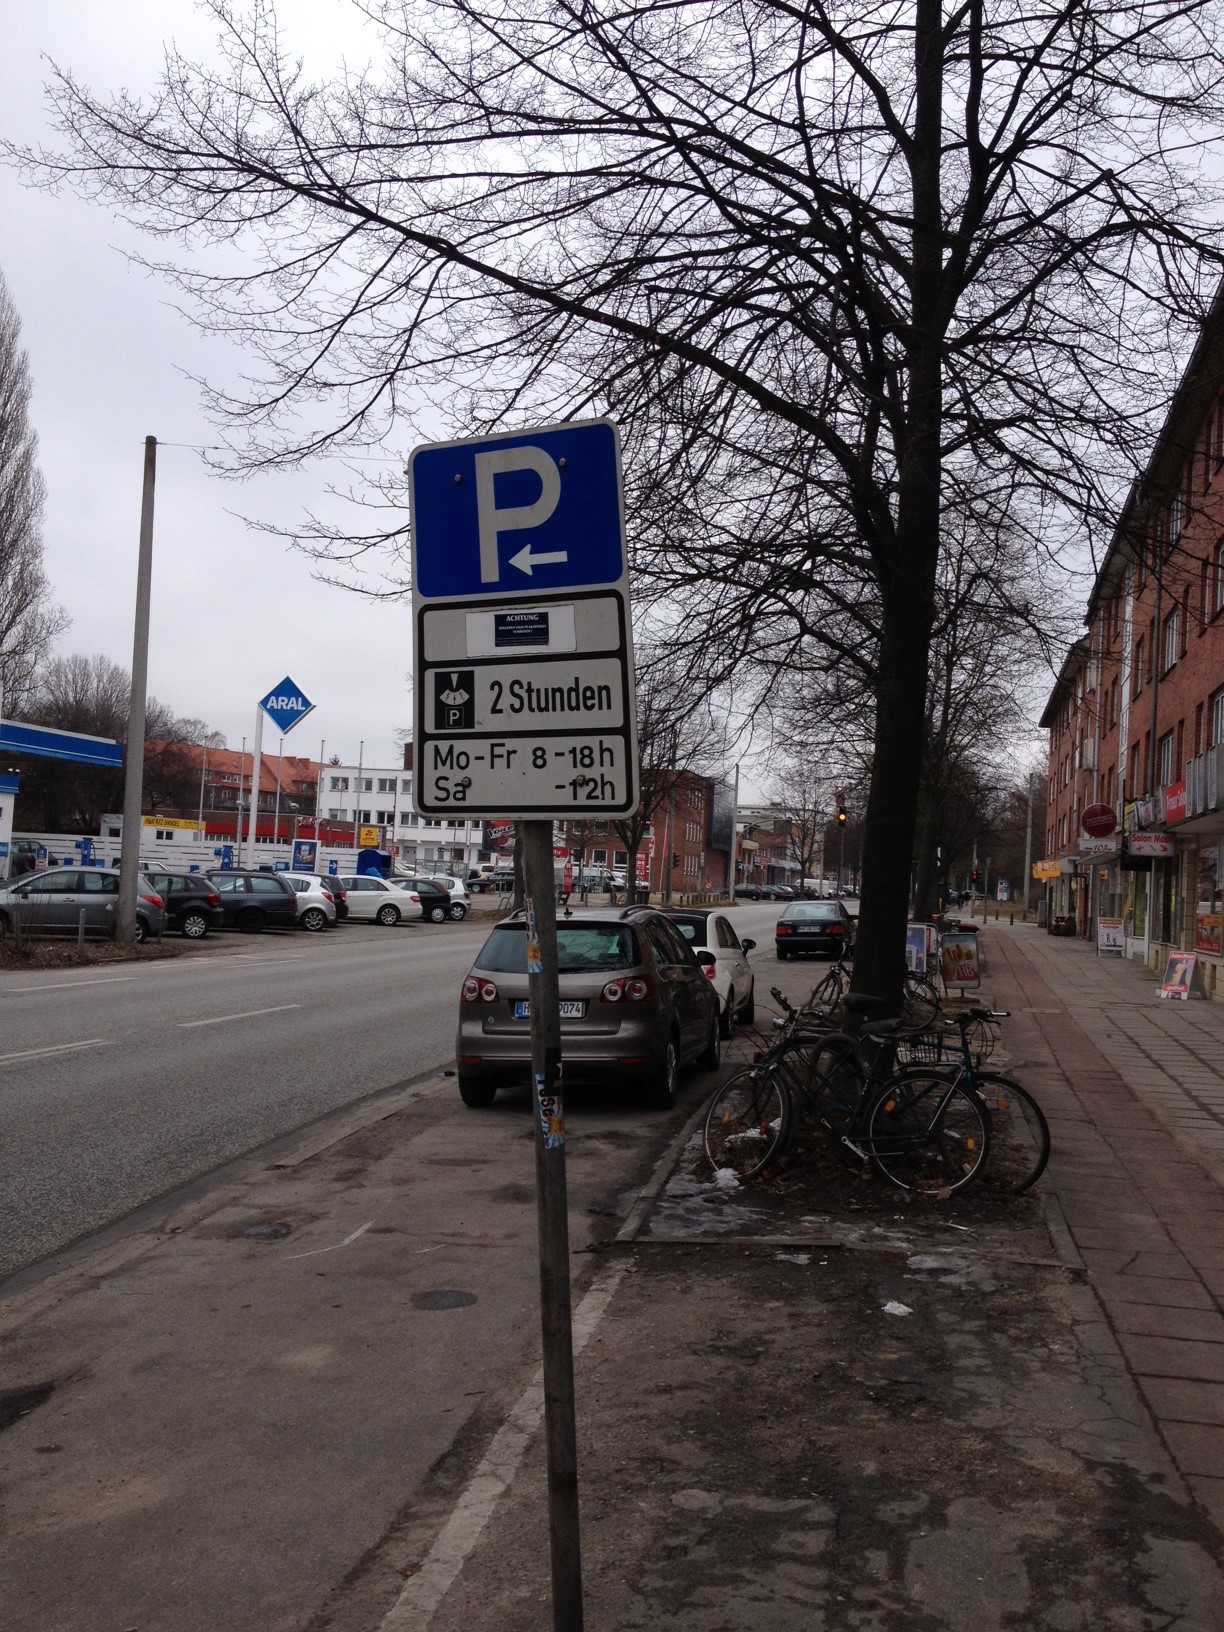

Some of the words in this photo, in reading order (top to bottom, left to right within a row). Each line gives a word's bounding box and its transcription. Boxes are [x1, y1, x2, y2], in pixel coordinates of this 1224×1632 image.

[475, 445, 562, 584] P
[266, 695, 306, 711] ARAL
[489, 680, 504, 714] 2
[509, 676, 612, 713] Stunden
[433, 775, 467, 802] Sa
[1132, 833, 1152, 843] Salon
[957, 964, 974, 978] HB
